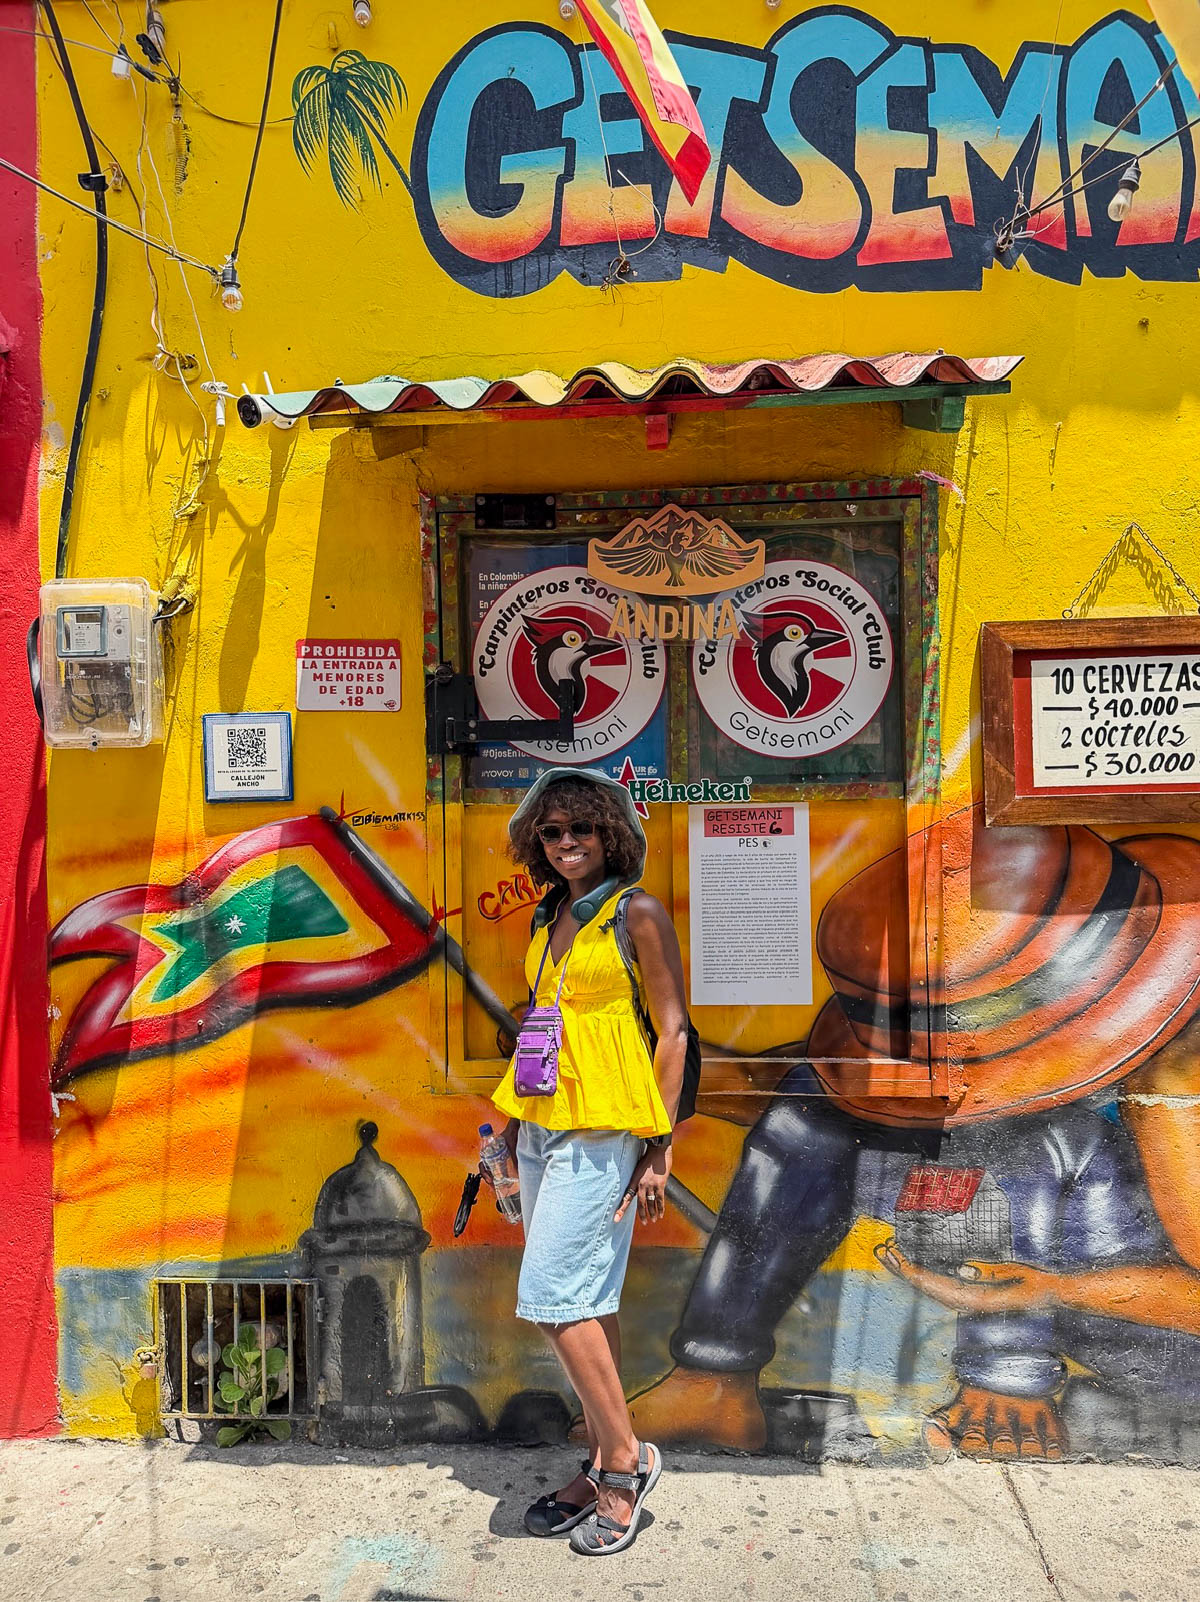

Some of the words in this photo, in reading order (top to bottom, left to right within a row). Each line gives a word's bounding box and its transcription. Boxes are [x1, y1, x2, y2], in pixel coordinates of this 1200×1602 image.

[412, 6, 1200, 290] GETSEMA
[478, 579, 570, 678] Carpinteros
[607, 597, 741, 641] ANDINA
[698, 574, 790, 675] Cateros
[795, 570, 867, 615] Social
[862, 612, 886, 670] Club
[301, 645, 397, 657] PROHIBIDA
[301, 660, 318, 670] LA
[323, 660, 384, 670] ENTRADA
[389, 660, 397, 670] A
[312, 672, 385, 682] MENORES
[1050, 667, 1074, 695] 10
[1082, 661, 1200, 694] CERVEZAS
[319, 685, 337, 695] DE
[345, 685, 385, 695] EDAD
[339, 696, 364, 707] +18
[1087, 696, 1179, 721] $40.000
[729, 707, 855, 749] Getsemani
[1060, 726, 1073, 749] 2
[1084, 751, 1196, 778] $30.000
[627, 778, 751, 802] Heineken
[707, 810, 783, 822] GETSEMANI
[712, 822, 767, 834] RESISTE
[738, 838, 759, 848] PES
